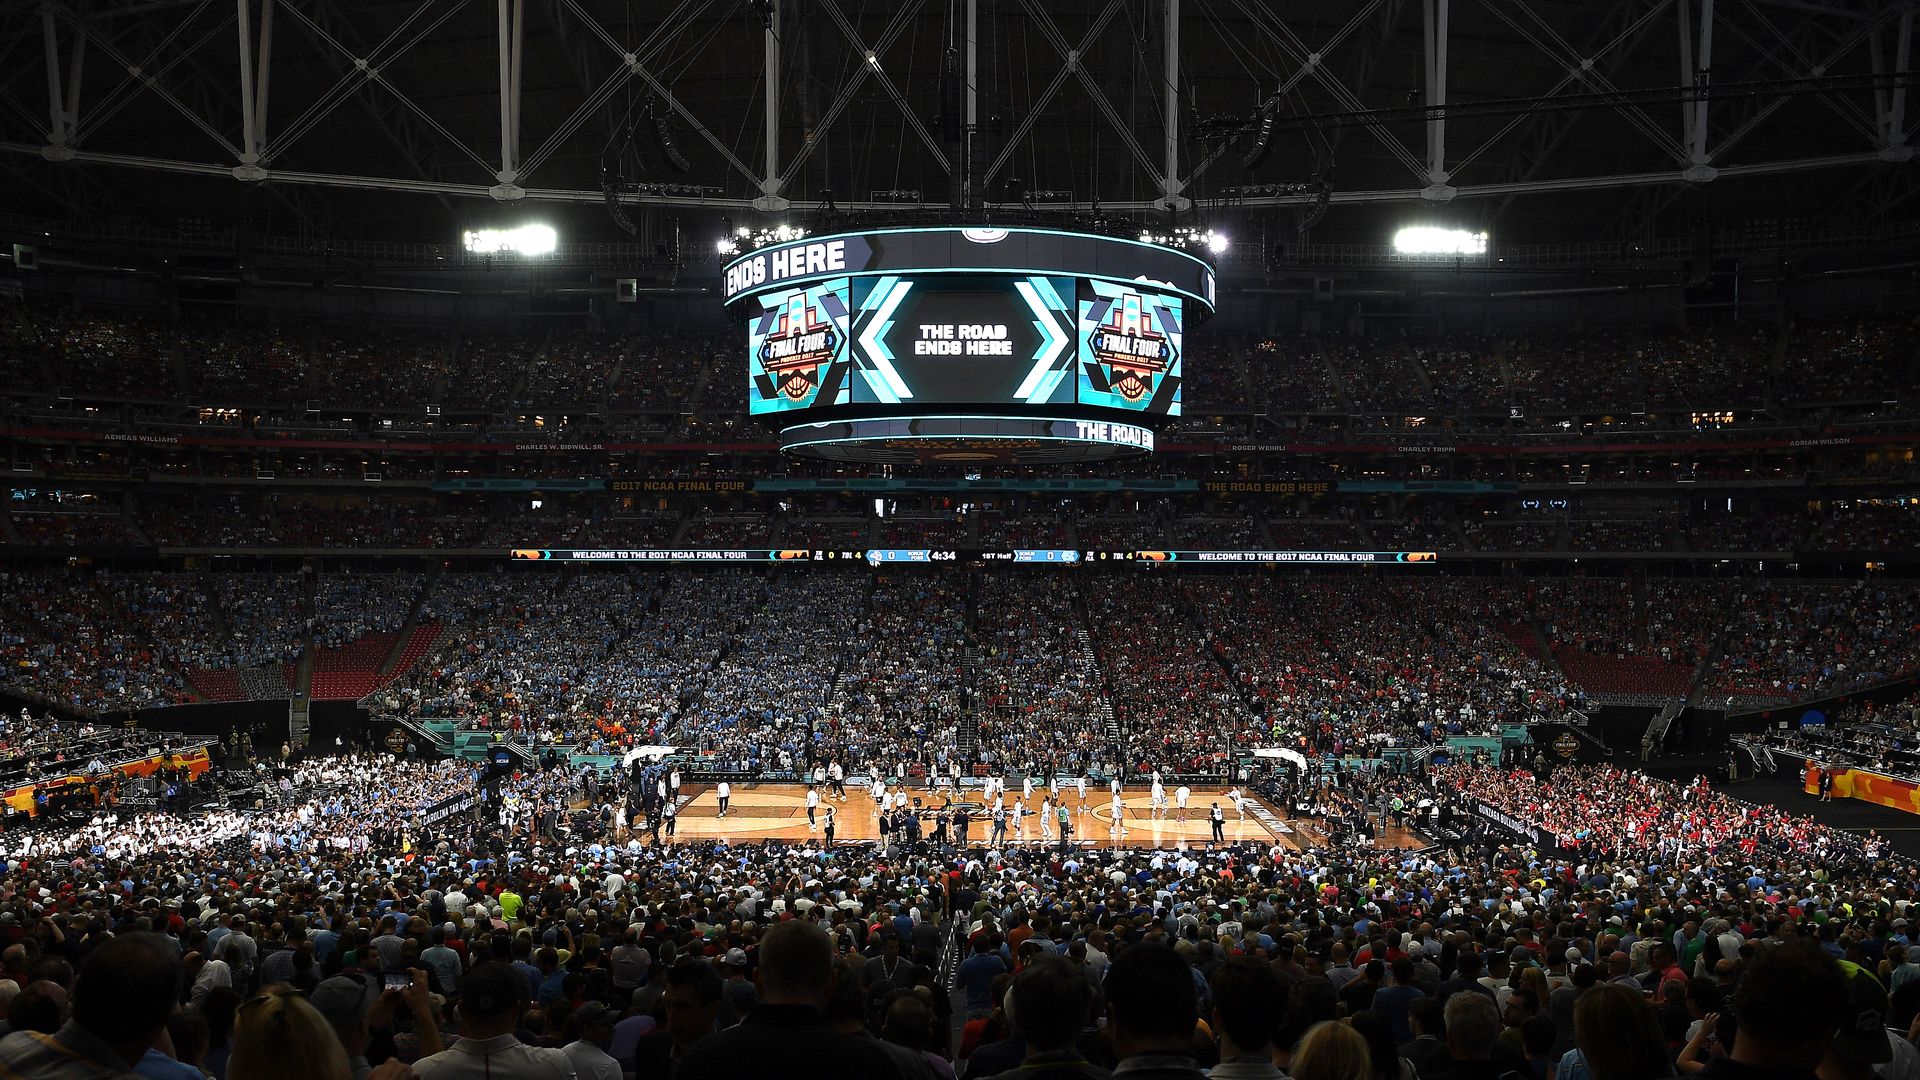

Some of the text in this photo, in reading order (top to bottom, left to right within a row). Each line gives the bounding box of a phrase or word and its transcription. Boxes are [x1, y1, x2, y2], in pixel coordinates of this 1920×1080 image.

[727, 240, 846, 297] ENDS HERE
[919, 324, 1008, 340] THE ROAD
[770, 331, 826, 358] FINAL FOUR
[914, 340, 1013, 356] ENDS HERE
[1102, 333, 1160, 358] FINAL FOUR
[1076, 421, 1108, 440] THE
[1110, 424, 1140, 444] ROAD
[104, 433, 179, 444] AENEAS WILLIAMS
[612, 481, 745, 490] 2017 NCAA FINAL FOUR
[1204, 482, 1328, 492] THE ROAD ENDS HERE
[572, 551, 747, 559] WELCOME TO THE 2017 NCAA FINAL FOUR
[828, 551, 834, 560] 0
[854, 551, 862, 560] 4
[888, 551, 896, 560] 0
[932, 550, 956, 560] 4:34
[1047, 552, 1054, 560] 0
[1100, 552, 1106, 560] 0
[1126, 552, 1134, 560] 4
[1198, 552, 1374, 560] WELCOME TO THE 2017 NCAA FINAL FOUR
[449, 802, 459, 814] TAR
